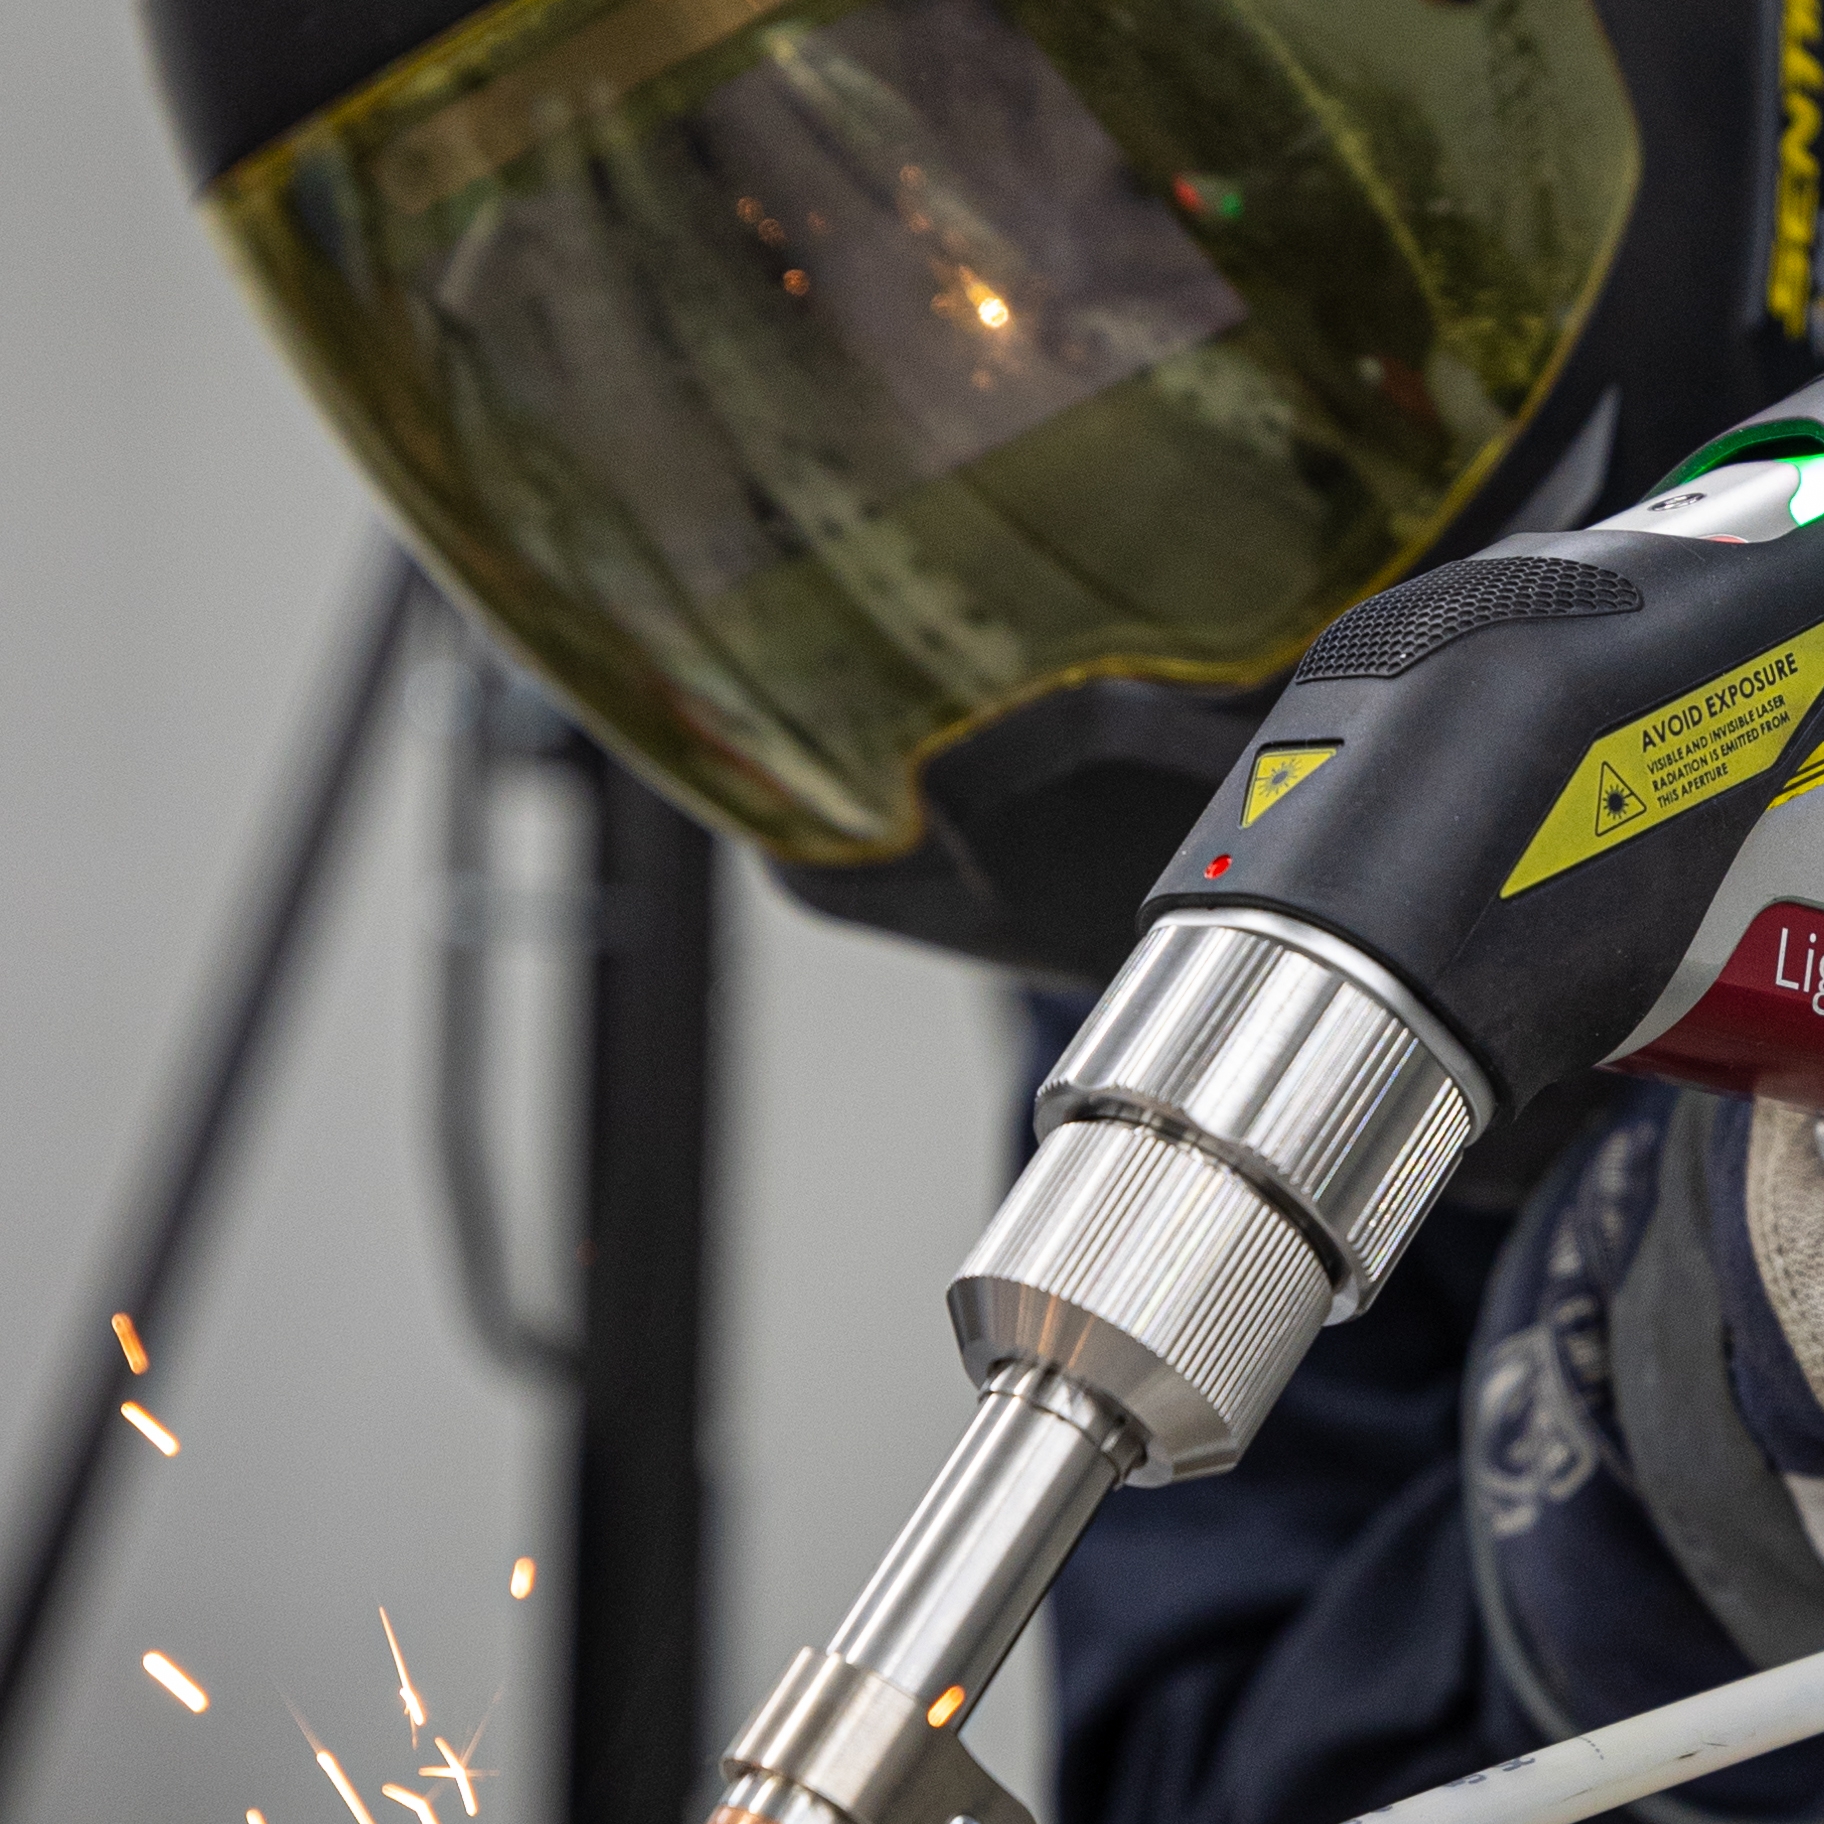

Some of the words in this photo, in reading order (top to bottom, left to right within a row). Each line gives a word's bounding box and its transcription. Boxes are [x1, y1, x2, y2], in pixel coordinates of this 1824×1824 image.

[1641, 704, 1703, 753] AVOID
[1704, 652, 1798, 718] EXPOSURE
[1647, 747, 1684, 775] VISIBLE
[1685, 735, 1708, 756] AND
[1709, 709, 1755, 742] INVISIBLE
[1755, 694, 1786, 719] LASER
[1652, 755, 1708, 792] RADIATION
[1710, 748, 1720, 763] IS
[1720, 727, 1760, 757] EMITTED
[1760, 710, 1791, 736] FROM
[1657, 788, 1680, 808] THIS
[1681, 762, 1729, 797] APERTURE
